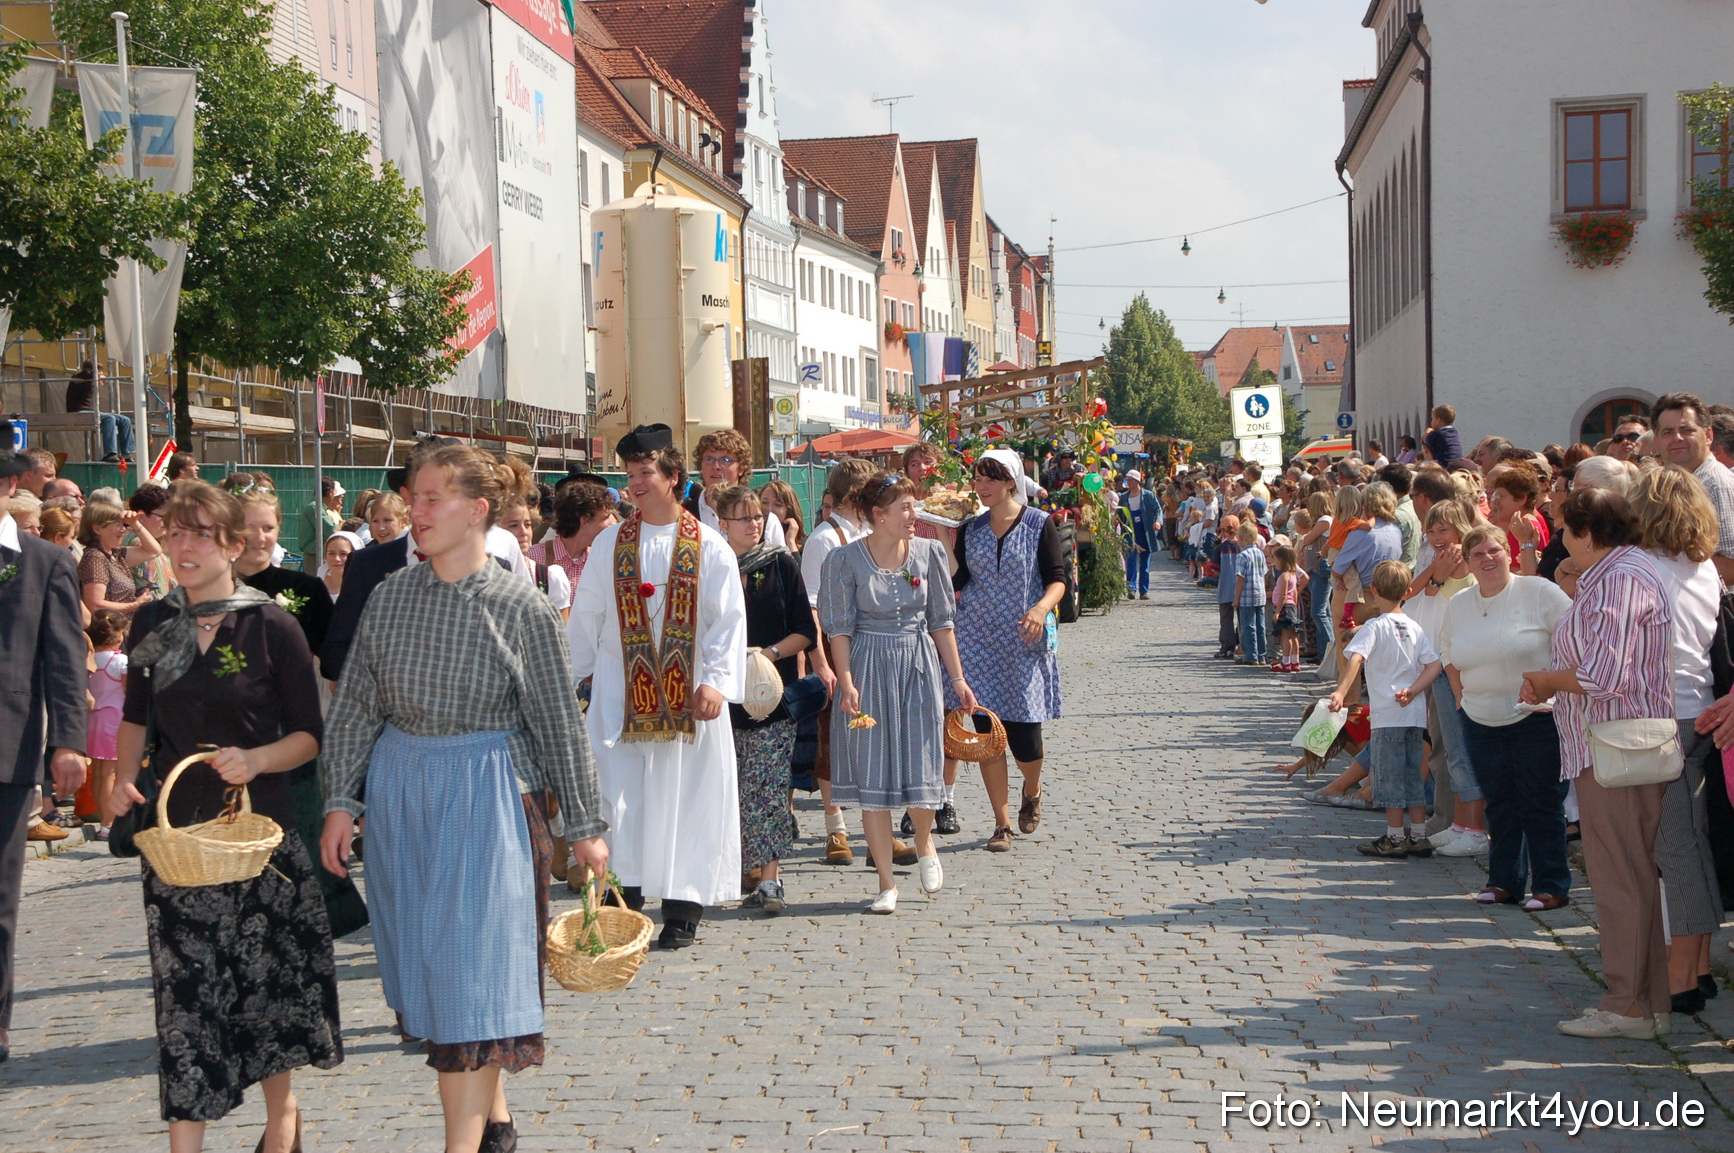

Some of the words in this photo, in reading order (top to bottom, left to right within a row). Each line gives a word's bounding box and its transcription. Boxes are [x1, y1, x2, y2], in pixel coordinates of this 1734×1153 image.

[502, 180, 524, 212] GERRY
[524, 189, 544, 222] WEBER
[1246, 422, 1271, 432] ZONE
